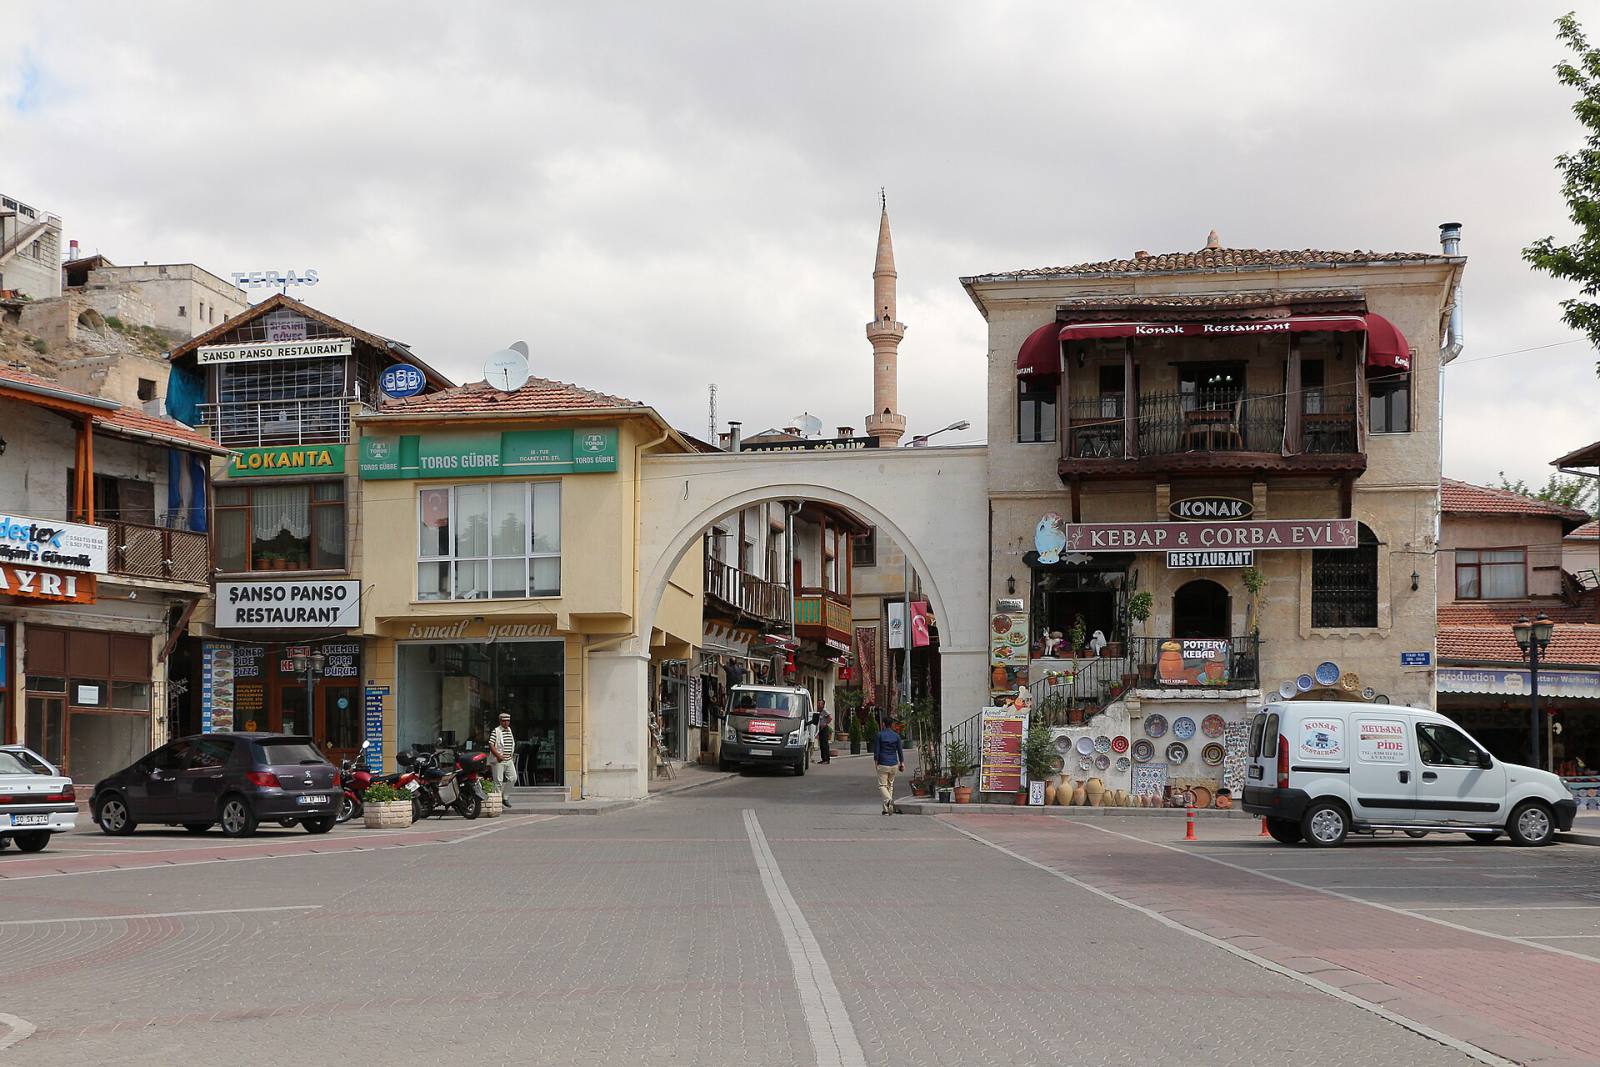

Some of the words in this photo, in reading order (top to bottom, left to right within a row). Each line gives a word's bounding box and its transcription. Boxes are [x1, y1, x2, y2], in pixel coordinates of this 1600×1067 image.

[231, 269, 318, 289] TERAS
[1135, 325, 1185, 335] Konak
[1203, 322, 1291, 333] Restaurant
[202, 350, 235, 363] ŞANSO
[240, 348, 273, 359] PANSO
[278, 344, 344, 356] RESTAURANT
[236, 450, 333, 470] LOKANTA
[420, 456, 458, 469] TOROS
[461, 452, 499, 468] GÜBRE
[595, 455, 615, 463] GÜBRE
[1179, 501, 1243, 517] KONAK
[1091, 529, 1168, 547] KEBAP
[1177, 531, 1190, 545] &
[1200, 527, 1282, 547] ÇORBA
[1291, 523, 1333, 544] EVİ
[1170, 552, 1251, 566] RESTAURANT
[229, 586, 286, 605] ŞANSO
[290, 585, 347, 601] PANSO
[236, 607, 340, 623] RESTAURANT
[408, 619, 469, 639] ismail
[485, 623, 552, 645] yaman
[1183, 640, 1225, 650] POTTERY
[1183, 650, 1215, 659] KEBAB
[1439, 671, 1496, 683] production
[1304, 722, 1337, 732] KONAK
[1361, 725, 1402, 734] MEVLANA
[1376, 739, 1403, 751] PİDE
